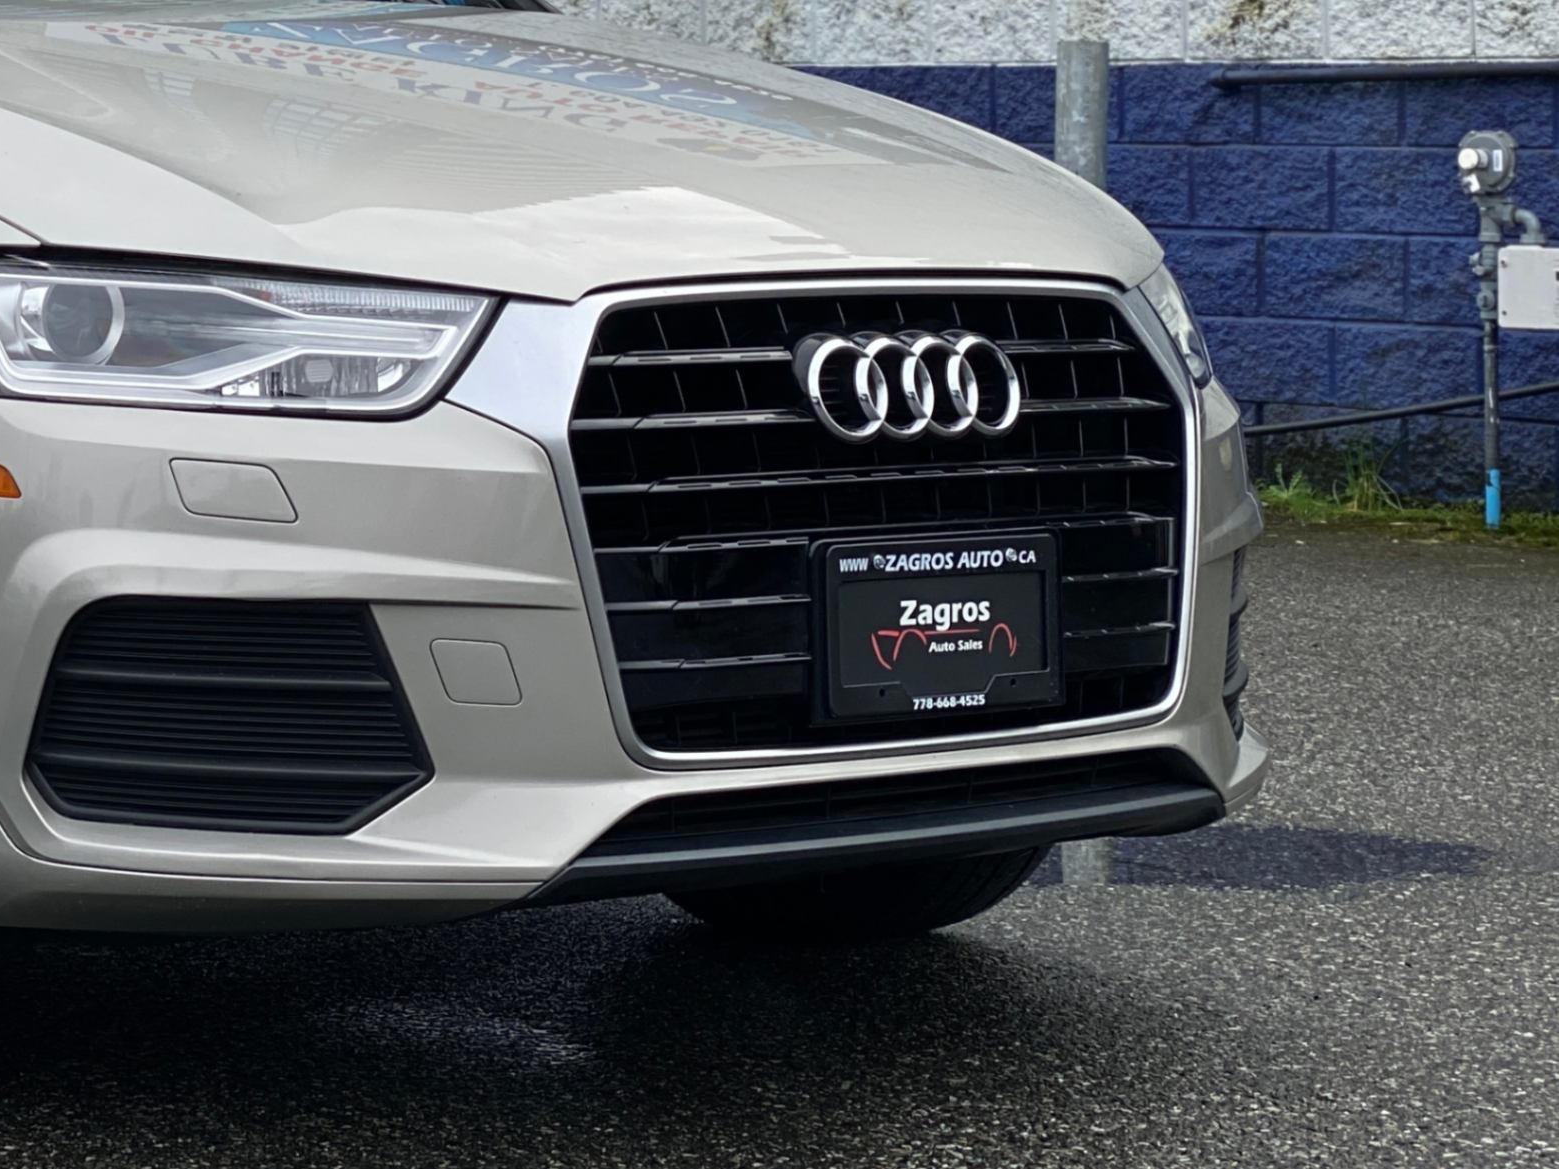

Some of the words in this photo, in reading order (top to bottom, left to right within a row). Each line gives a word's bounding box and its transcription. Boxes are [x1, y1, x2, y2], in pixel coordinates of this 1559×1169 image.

[885, 553, 954, 573] ZAGROS
[957, 550, 1003, 570] AUTO
[899, 600, 990, 631] Zagros
[928, 639, 955, 653] Auto
[957, 638, 983, 652] Sales
[912, 693, 986, 711] 778-668-4525
